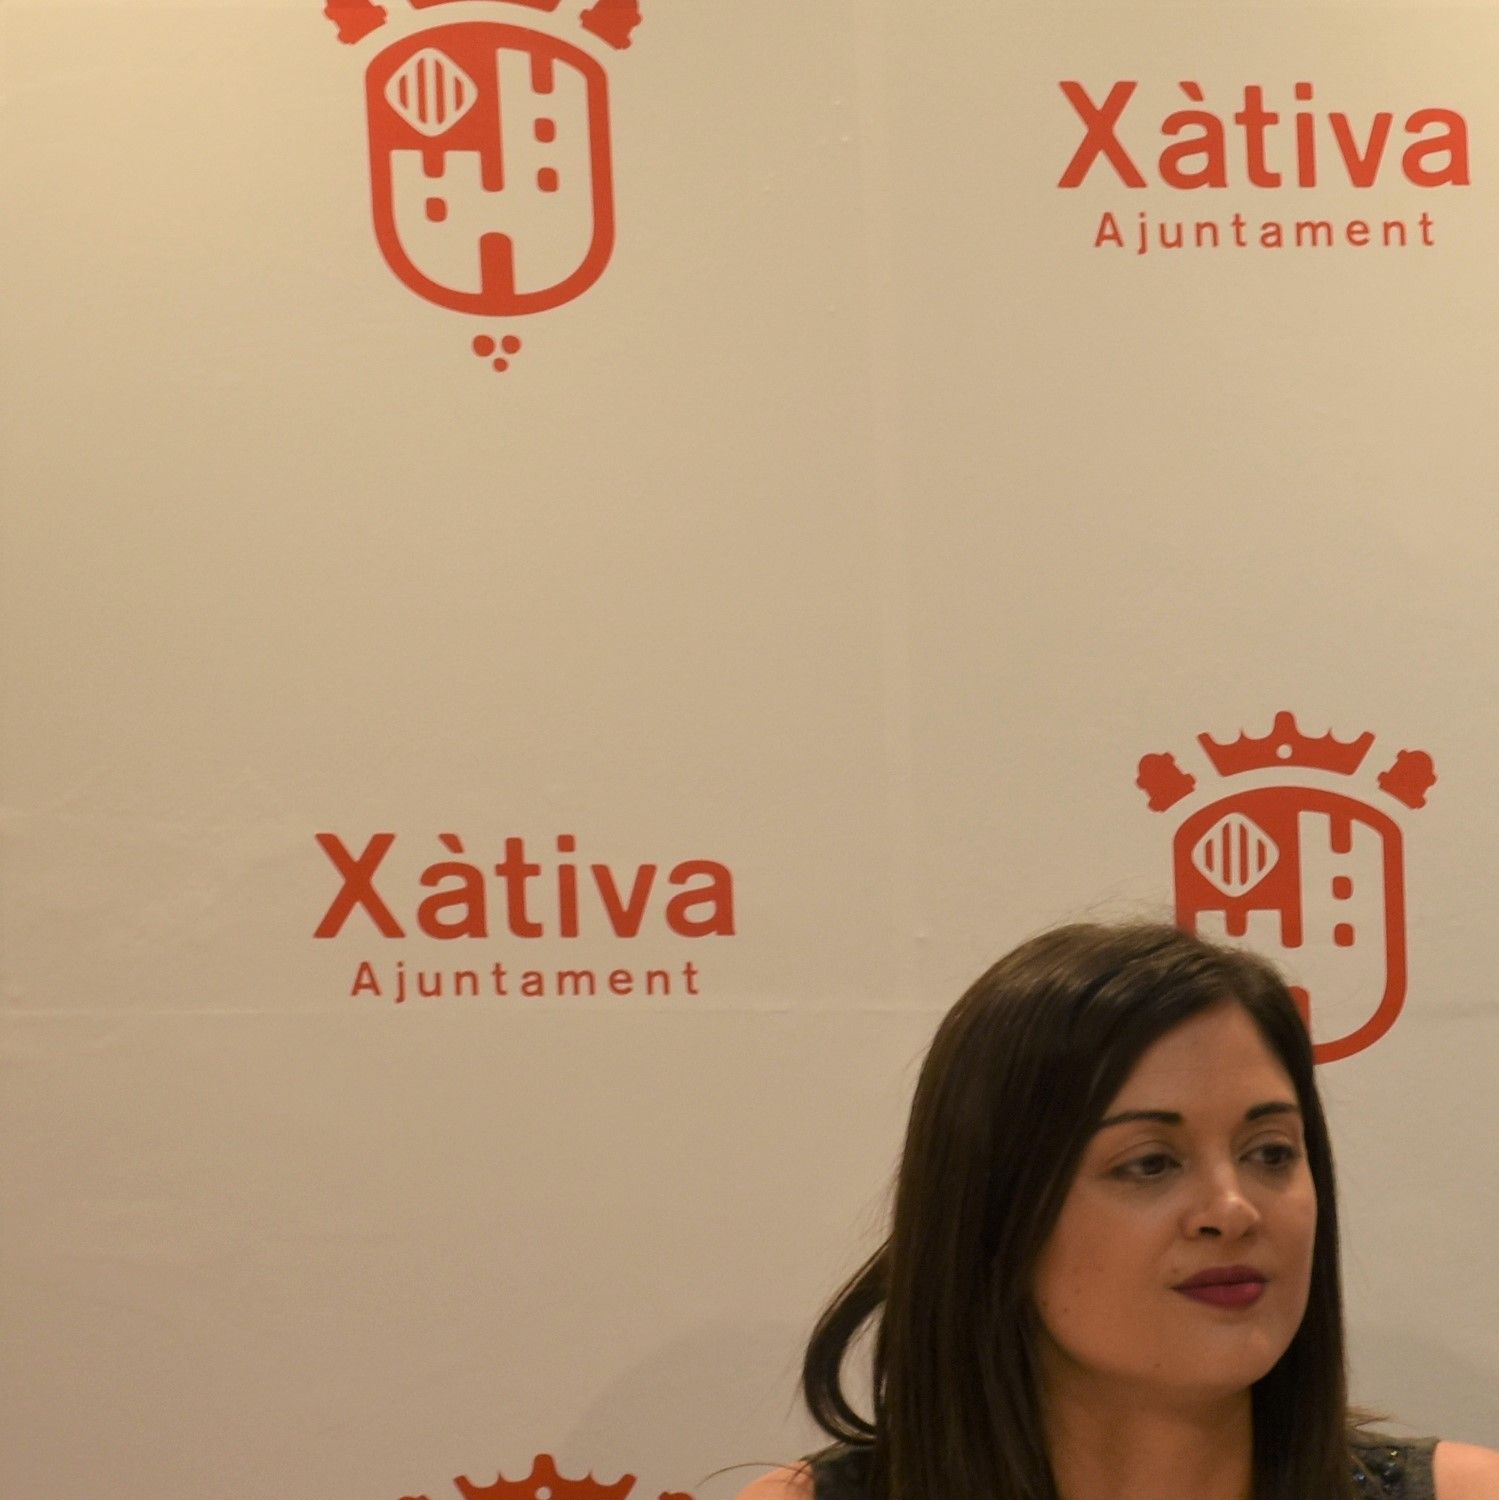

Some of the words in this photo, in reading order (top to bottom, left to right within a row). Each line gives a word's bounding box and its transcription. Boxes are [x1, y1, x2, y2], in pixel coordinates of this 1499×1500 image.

[1057, 79, 1474, 193] Xàtiva
[1094, 212, 1437, 258] Ajuntament
[314, 831, 739, 943] Xàtiva
[350, 959, 700, 1005] Ajuntament
